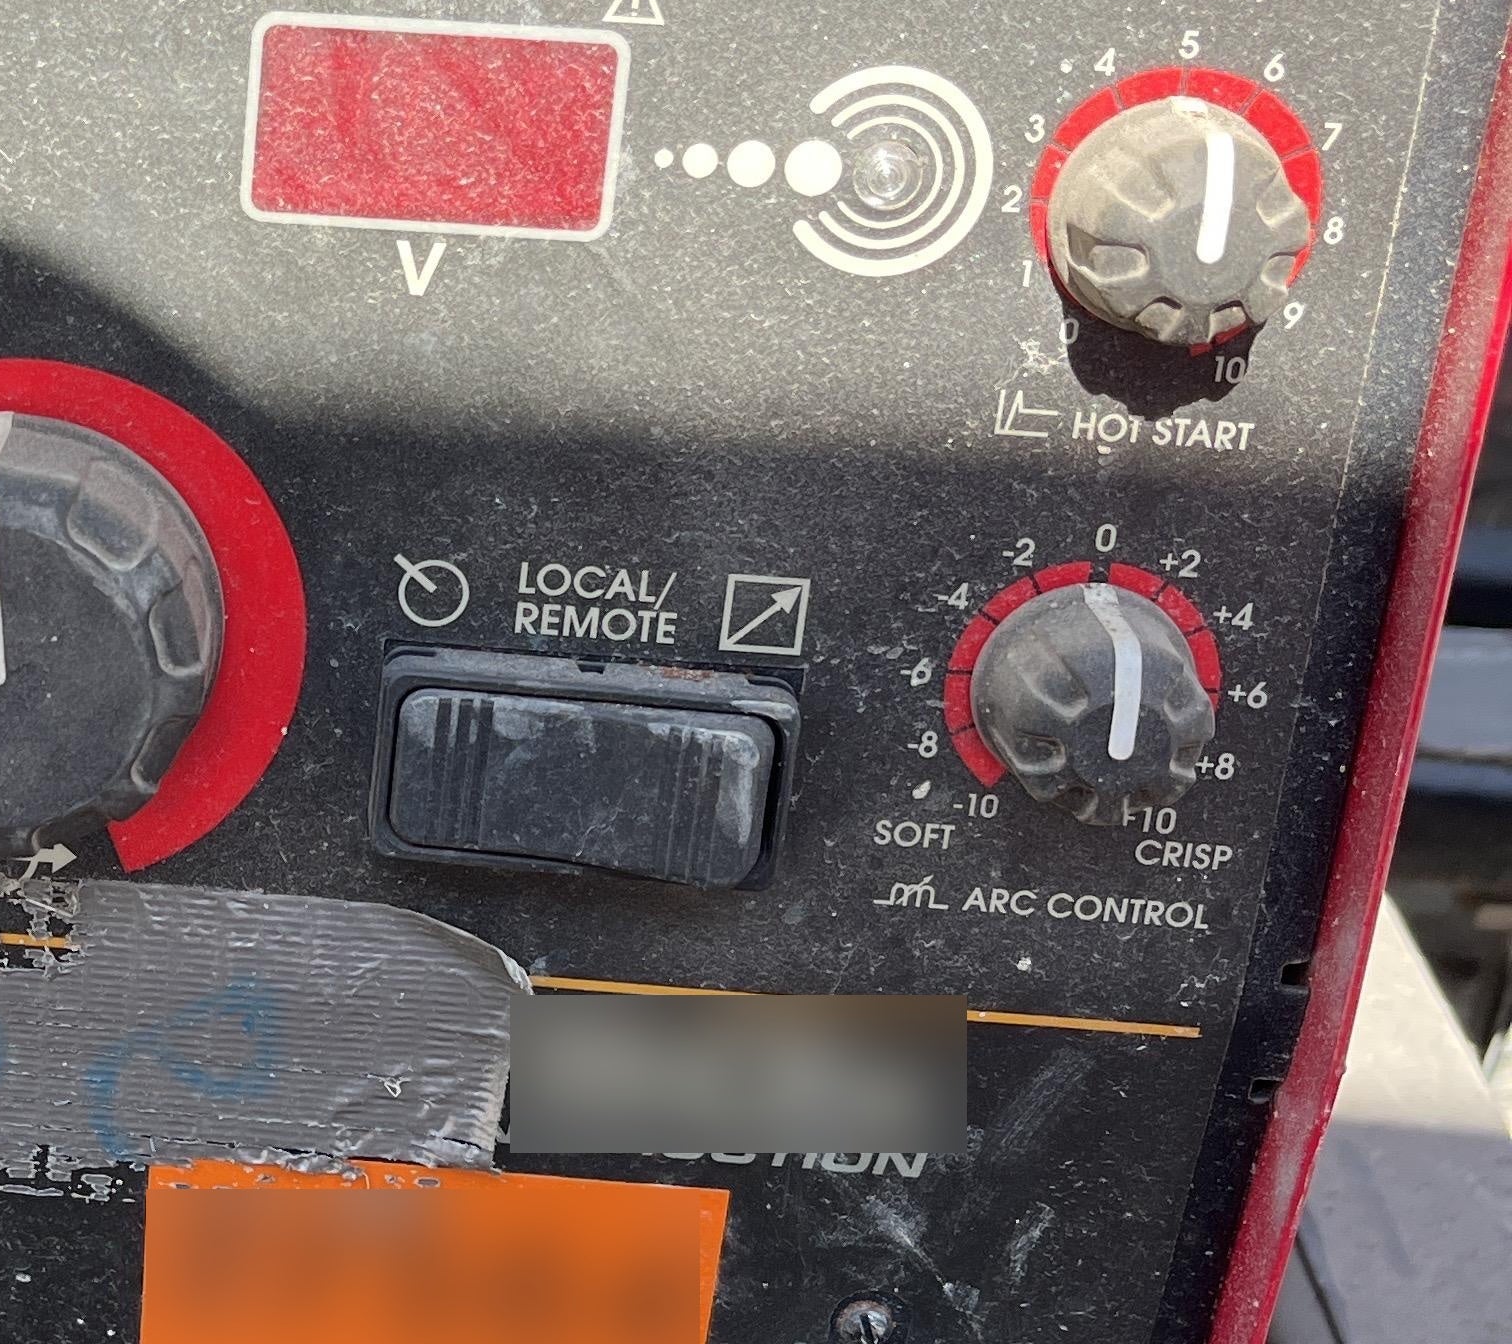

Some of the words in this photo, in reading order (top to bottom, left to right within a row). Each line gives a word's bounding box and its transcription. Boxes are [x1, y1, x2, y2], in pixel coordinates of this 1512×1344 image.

[1178, 30, 1200, 59] 5
[1094, 48, 1117, 76] 4
[1263, 54, 1286, 82] 6
[1024, 114, 1046, 143] 3
[1322, 123, 1342, 151] 7
[1001, 185, 1023, 213] 2
[1323, 216, 1344, 245] 8
[396, 240, 448, 297] V
[1022, 260, 1033, 287] 1
[1283, 303, 1304, 329] 9
[1214, 355, 1246, 384] 10
[1071, 411, 1141, 443] HOT
[1152, 417, 1255, 450] START
[1095, 523, 1118, 552] 0
[1002, 538, 1036, 567] -2
[1160, 550, 1201, 578] +2
[518, 562, 677, 610] LOCAL/
[937, 583, 969, 610] -4
[514, 602, 677, 645] REMOTE
[1213, 602, 1255, 630] +4
[900, 658, 933, 687] -6
[1227, 681, 1268, 709] +6
[907, 731, 938, 758] -8
[1195, 753, 1235, 780] +8
[953, 793, 999, 818] -10
[873, 820, 956, 850] SOFT
[1134, 839, 1233, 871] CRISP
[962, 888, 1037, 916] ARC
[1047, 892, 1209, 929] CONTROL
